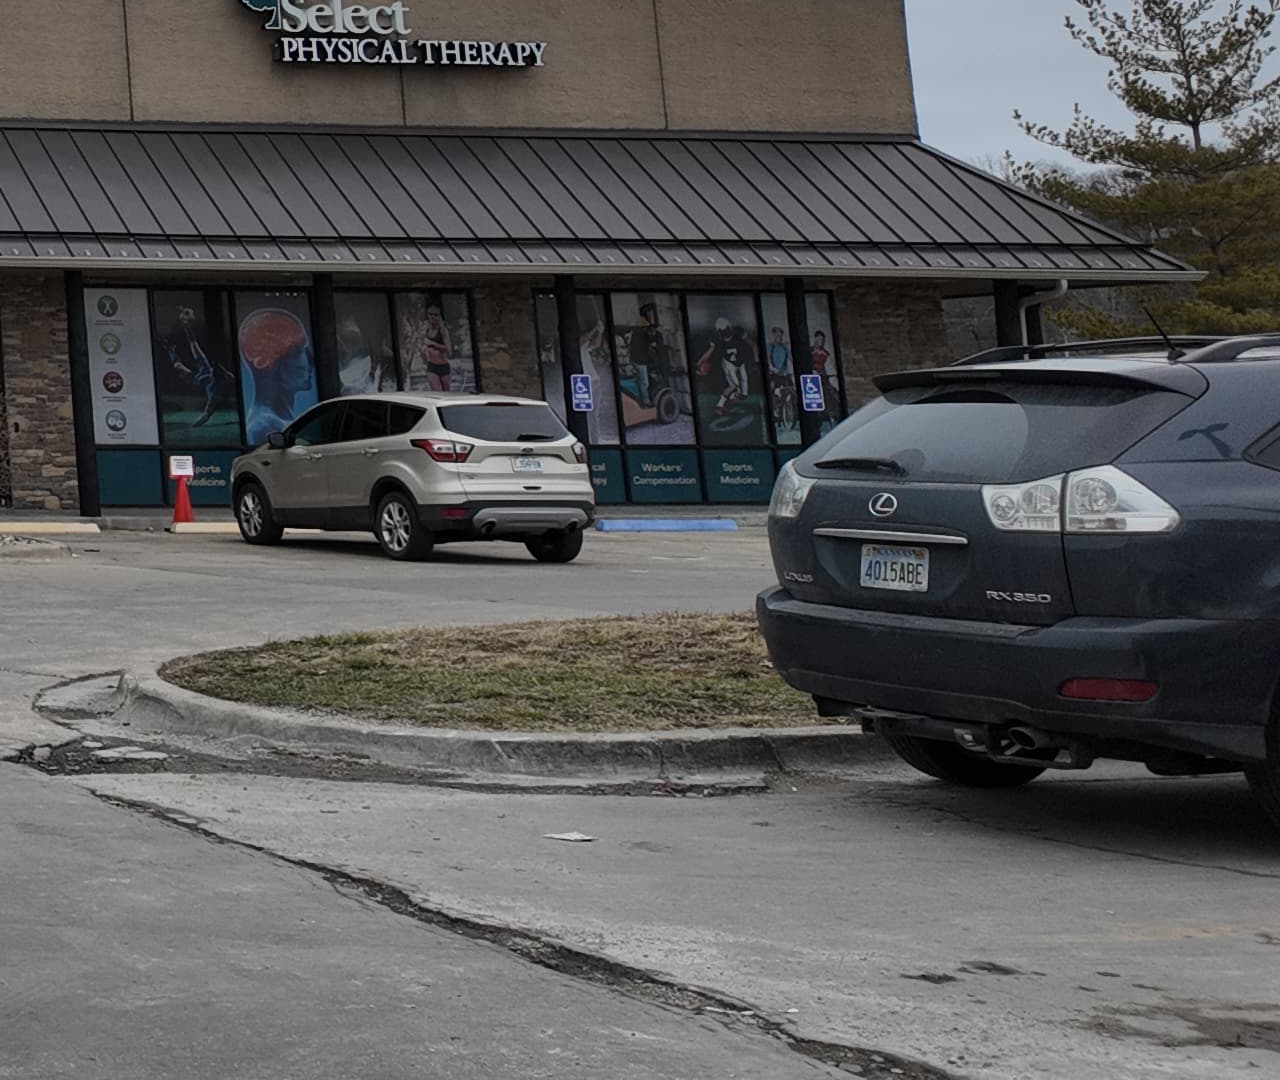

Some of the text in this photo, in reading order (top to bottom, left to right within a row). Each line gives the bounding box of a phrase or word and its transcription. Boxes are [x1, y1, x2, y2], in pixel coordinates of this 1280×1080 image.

[281, 37, 547, 66] PHYSICAL THERAPY
[195, 465, 221, 474] ports
[722, 462, 753, 474] Sports
[633, 475, 697, 487] Compensation
[720, 475, 760, 486] Medicine
[865, 560, 923, 584] 4015ABE
